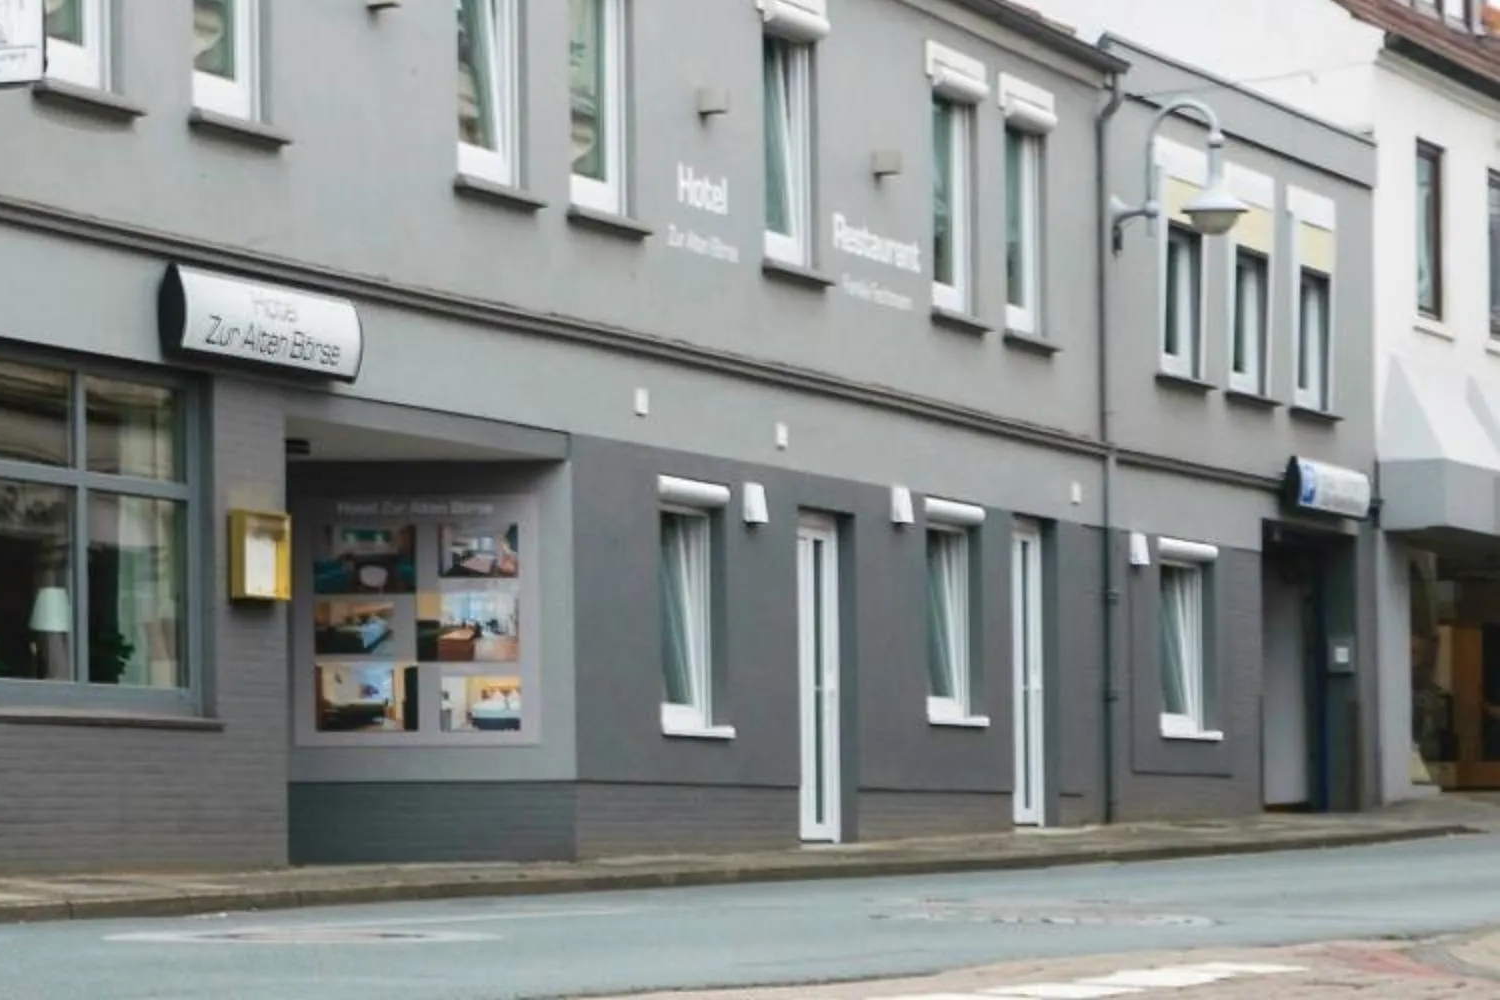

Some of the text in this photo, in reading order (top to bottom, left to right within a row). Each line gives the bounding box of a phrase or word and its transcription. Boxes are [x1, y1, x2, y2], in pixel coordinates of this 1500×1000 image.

[677, 161, 729, 216] Hotel
[832, 211, 921, 273] Restaurant
[204, 313, 342, 367] Zur Alten Börse
